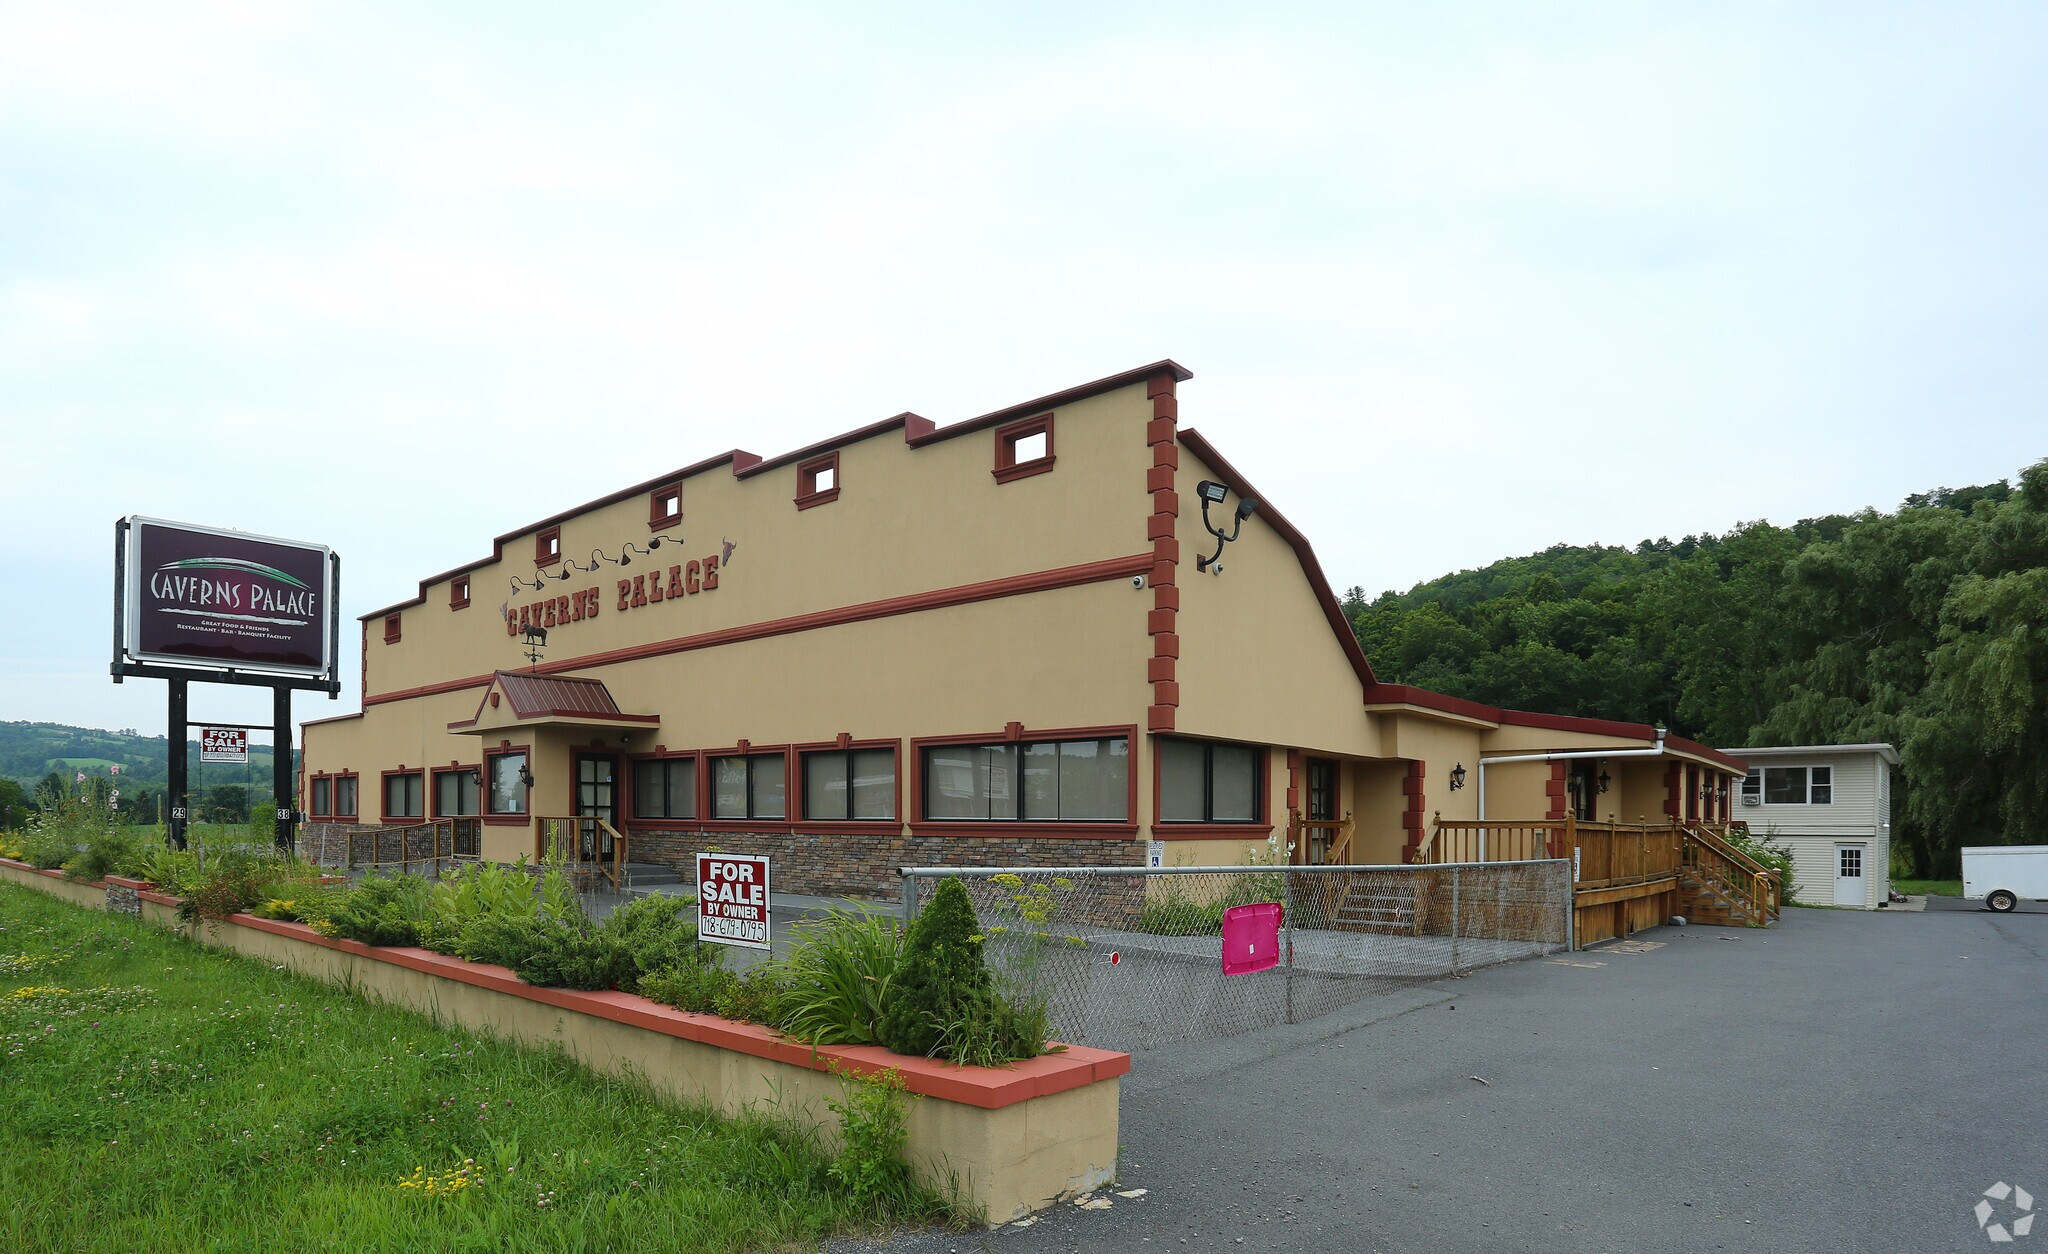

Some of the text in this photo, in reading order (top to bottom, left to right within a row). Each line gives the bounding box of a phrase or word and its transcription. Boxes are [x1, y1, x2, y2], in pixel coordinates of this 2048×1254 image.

[151, 572, 315, 617] CAVERNS PALACE
[507, 555, 719, 637] CAVERNS PALACE
[177, 623, 217, 633] RESTAURANT
[238, 630, 266, 638] BANQUET
[266, 632, 292, 640] FACILITY
[204, 737, 245, 748] SALE
[210, 730, 239, 739] FOR
[173, 808, 185, 818] 29
[709, 862, 754, 883] FOR
[702, 880, 764, 906] SALE
[707, 902, 758, 920] BY OWNER
